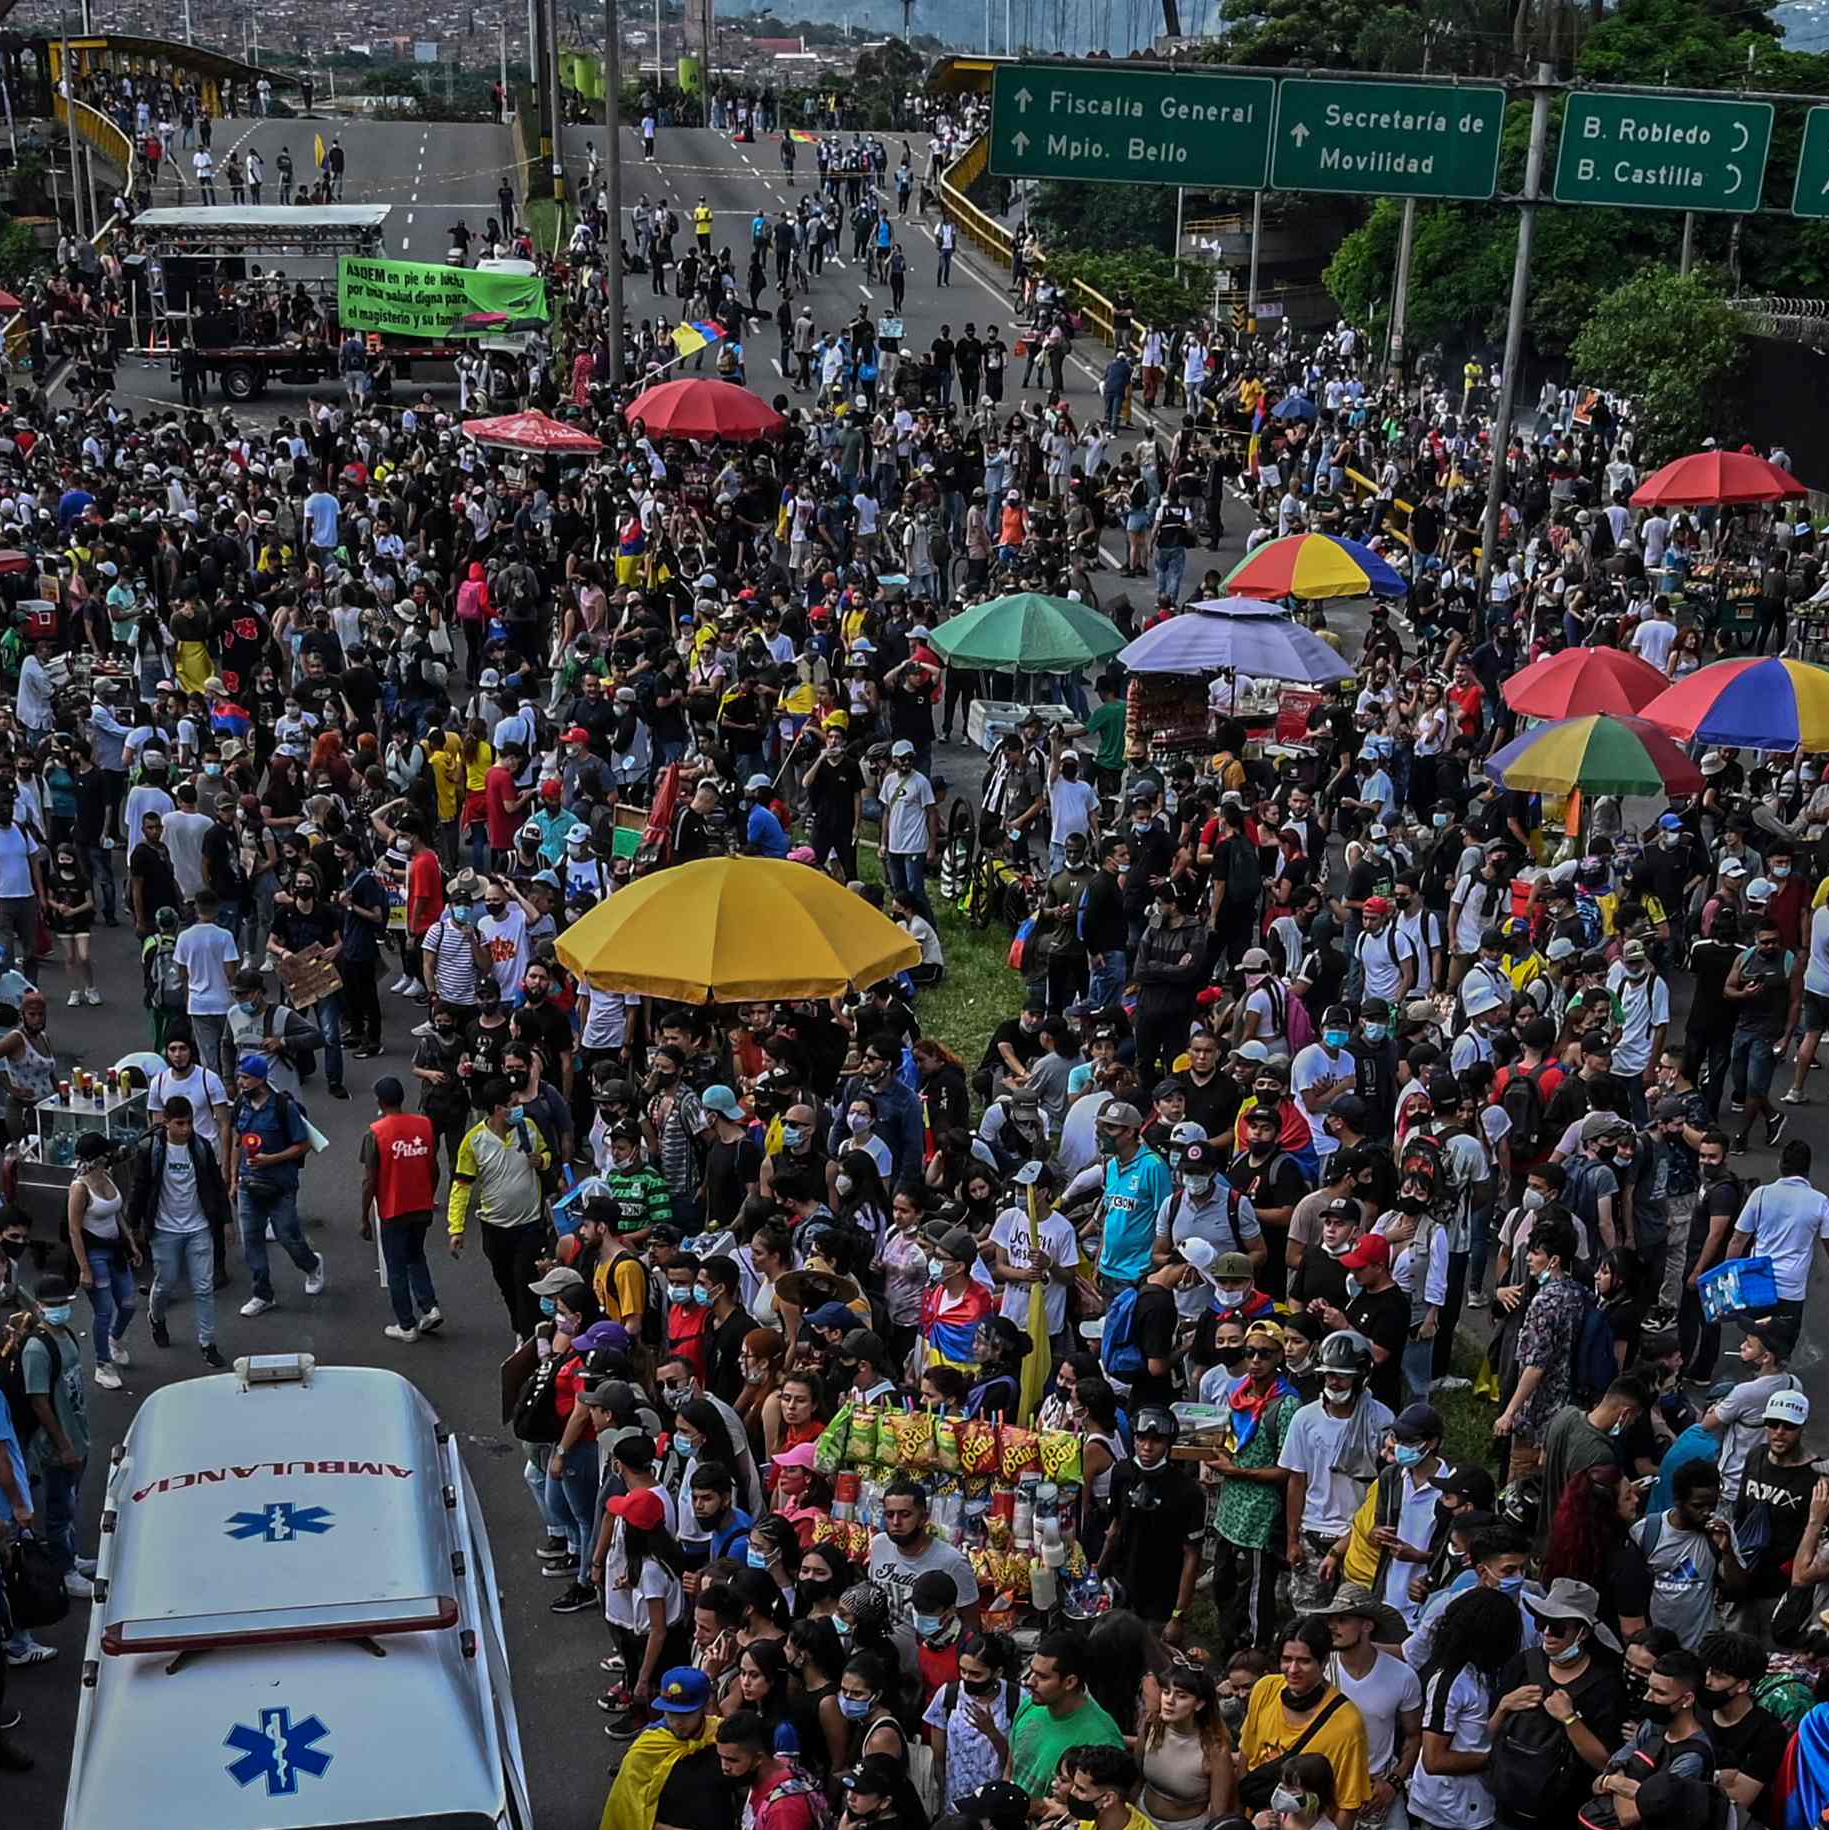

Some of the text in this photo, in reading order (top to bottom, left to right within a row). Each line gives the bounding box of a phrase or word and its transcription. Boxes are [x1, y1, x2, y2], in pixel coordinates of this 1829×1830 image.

[1160, 96, 1254, 123] General
[1324, 103, 1485, 134] Secretaría de
[1582, 116, 1712, 145] B. Robledo
[1046, 133, 1188, 163] Mpio. Bello
[1319, 146, 1435, 175] Movilidad
[1577, 157, 1704, 187] B. Castilla
[387, 273, 400, 285] en
[424, 271, 437, 285] de
[346, 285, 363, 298] por
[384, 290, 413, 303] salud
[415, 291, 442, 307] digna
[445, 293, 469, 306] para
[359, 309, 411, 325] magisterio
[413, 315, 421, 329] y
[422, 314, 434, 325] su
[131, 1460, 415, 1504] AMBULANCIA
[874, 1562, 919, 1588] Indi
